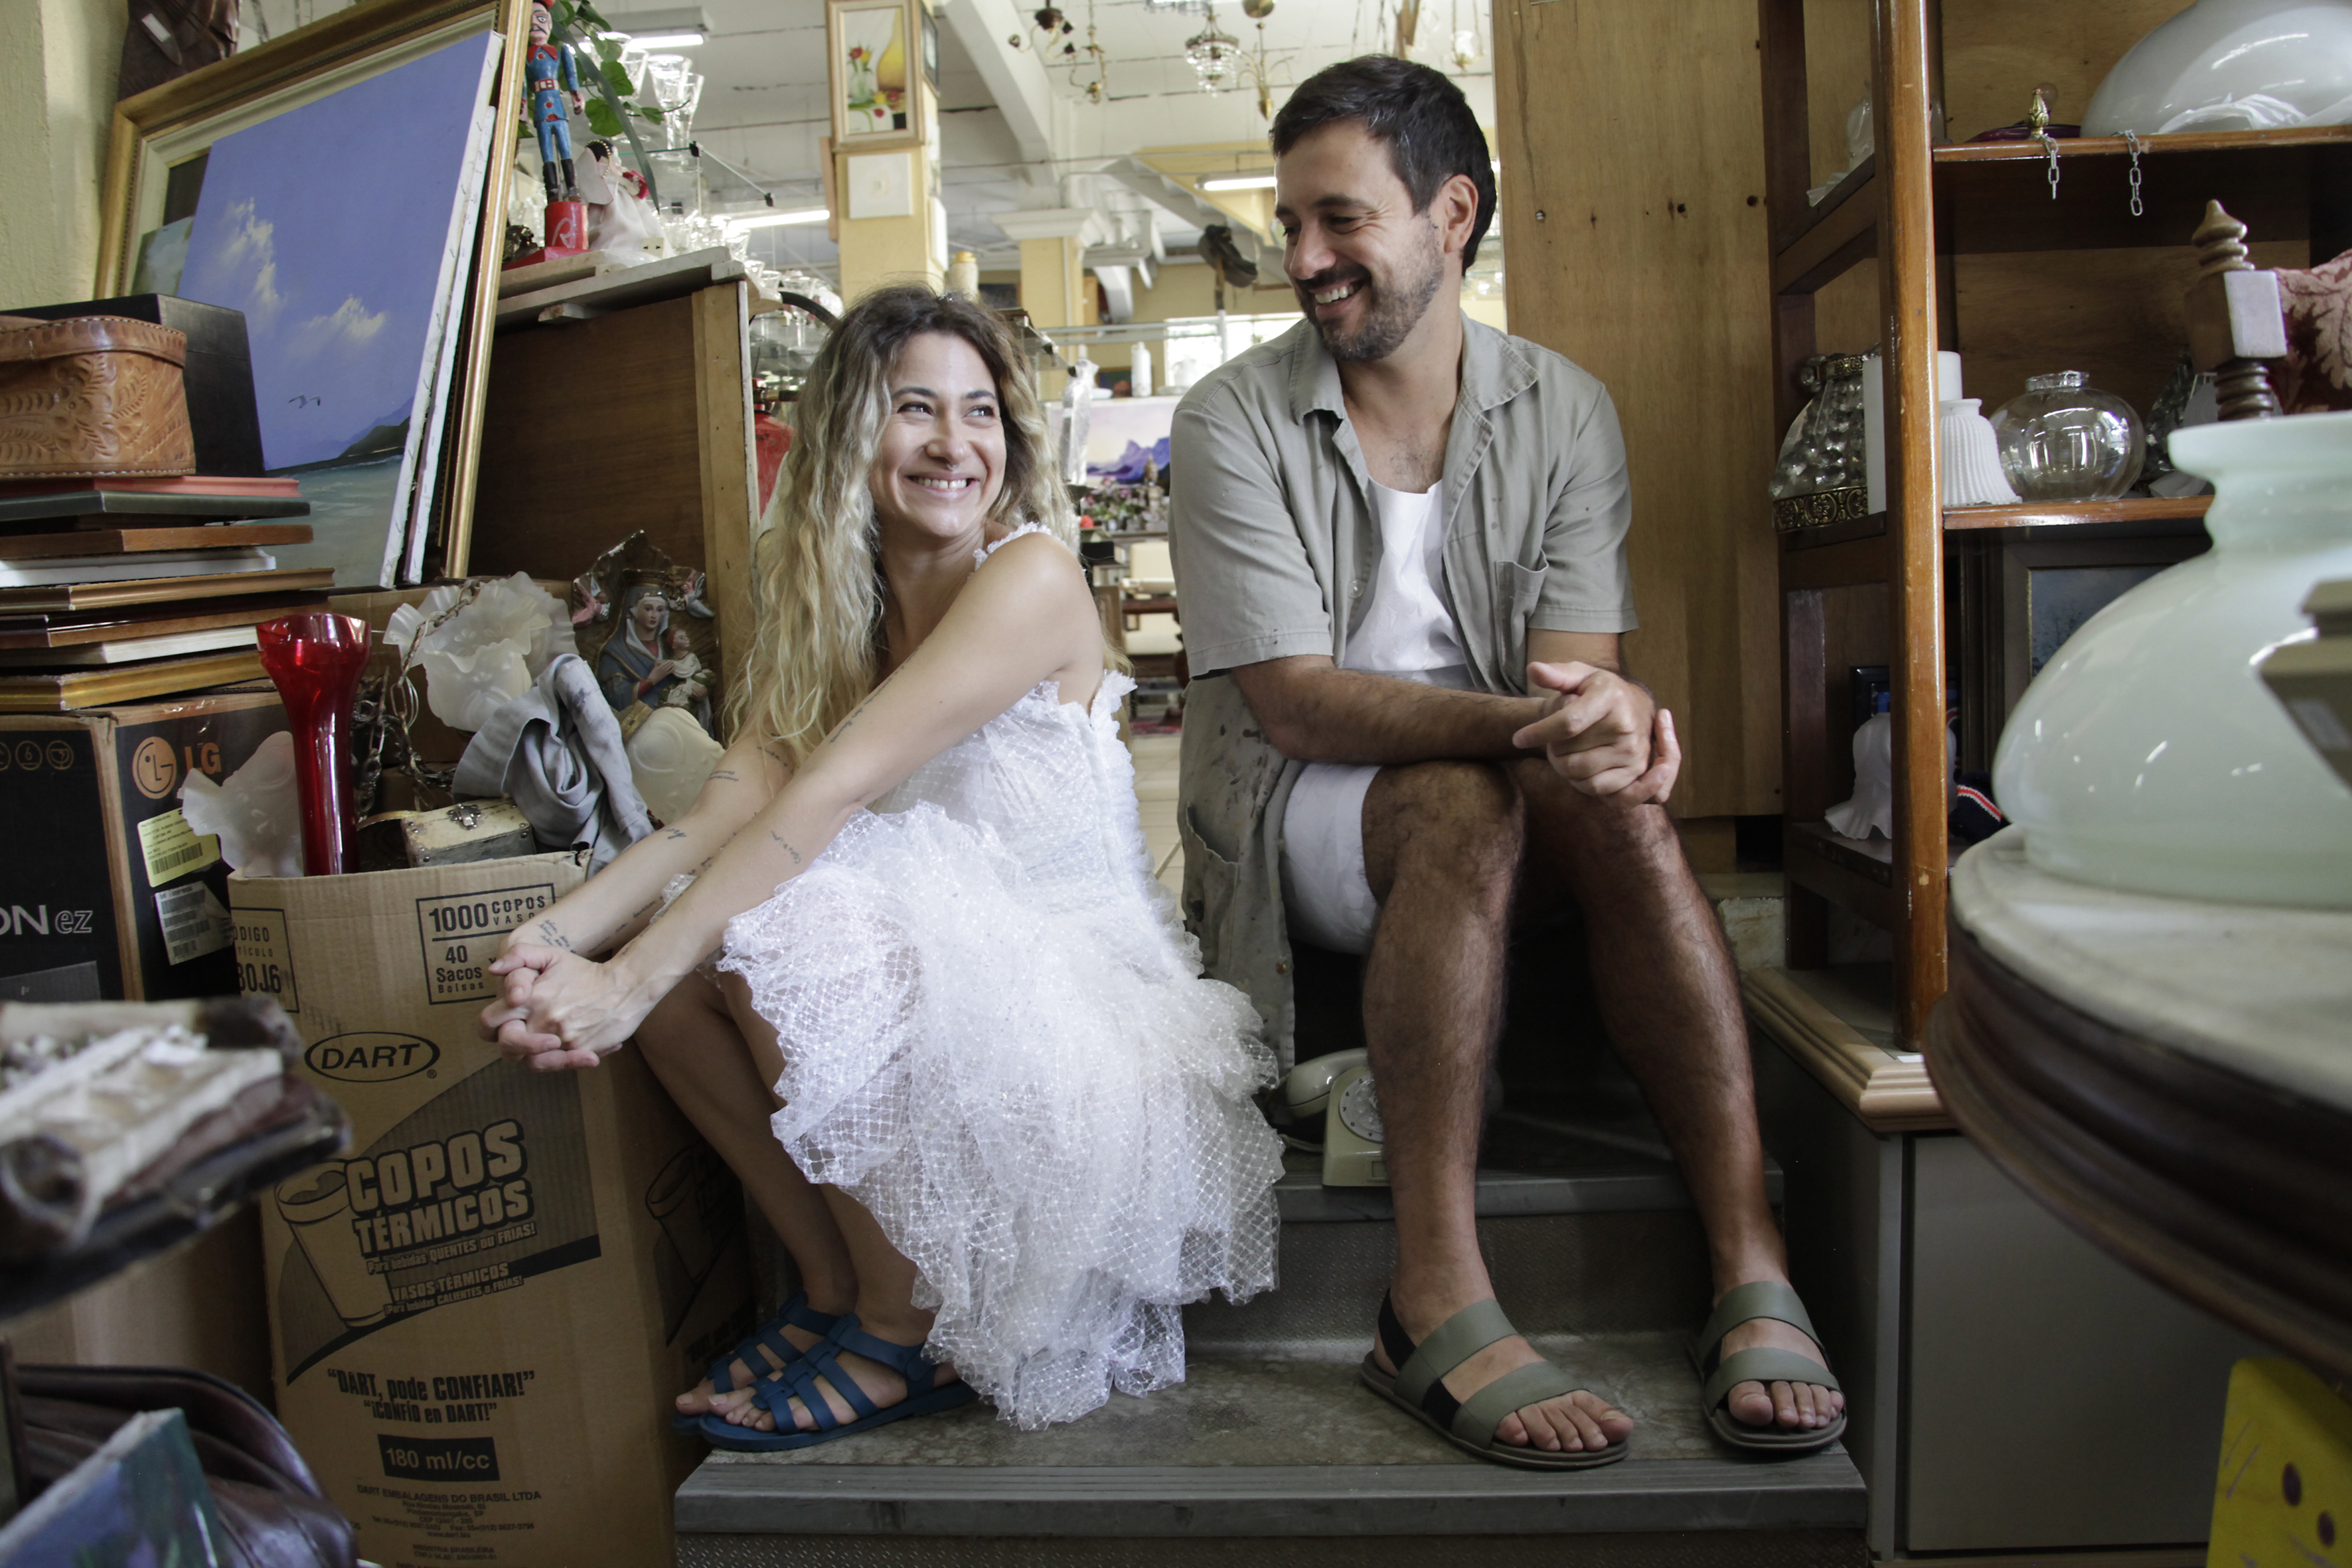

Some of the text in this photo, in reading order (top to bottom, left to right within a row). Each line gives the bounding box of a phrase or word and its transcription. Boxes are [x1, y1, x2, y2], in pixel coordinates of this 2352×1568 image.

[185, 742, 222, 775] LG
[55, 910, 93, 934] ez
[429, 896, 546, 932] 1000 COPOS
[232, 922, 270, 942] ÓDIGO
[238, 945, 273, 957] TÍCULO
[445, 945, 467, 964] 40
[436, 967, 483, 983] Sacos
[438, 982, 484, 993] Bolsas
[321, 1043, 420, 1069] DART
[347, 1119, 525, 1216] COPOS
[352, 1178, 534, 1259] TÉRMICOS
[367, 1259, 389, 1275] Para
[391, 1253, 428, 1271] bebidas
[429, 1239, 479, 1264] QUENTES
[392, 1263, 509, 1301] VASOS TÉRMICOS
[437, 1285, 483, 1306] CALIENTES
[386, 1377, 428, 1402] pode
[424, 1407, 443, 1423] en
[386, 1447, 491, 1470] 180 ml/cc
[357, 1484, 542, 1504] DART EMBALAGENS DO BRASIL LTDA
